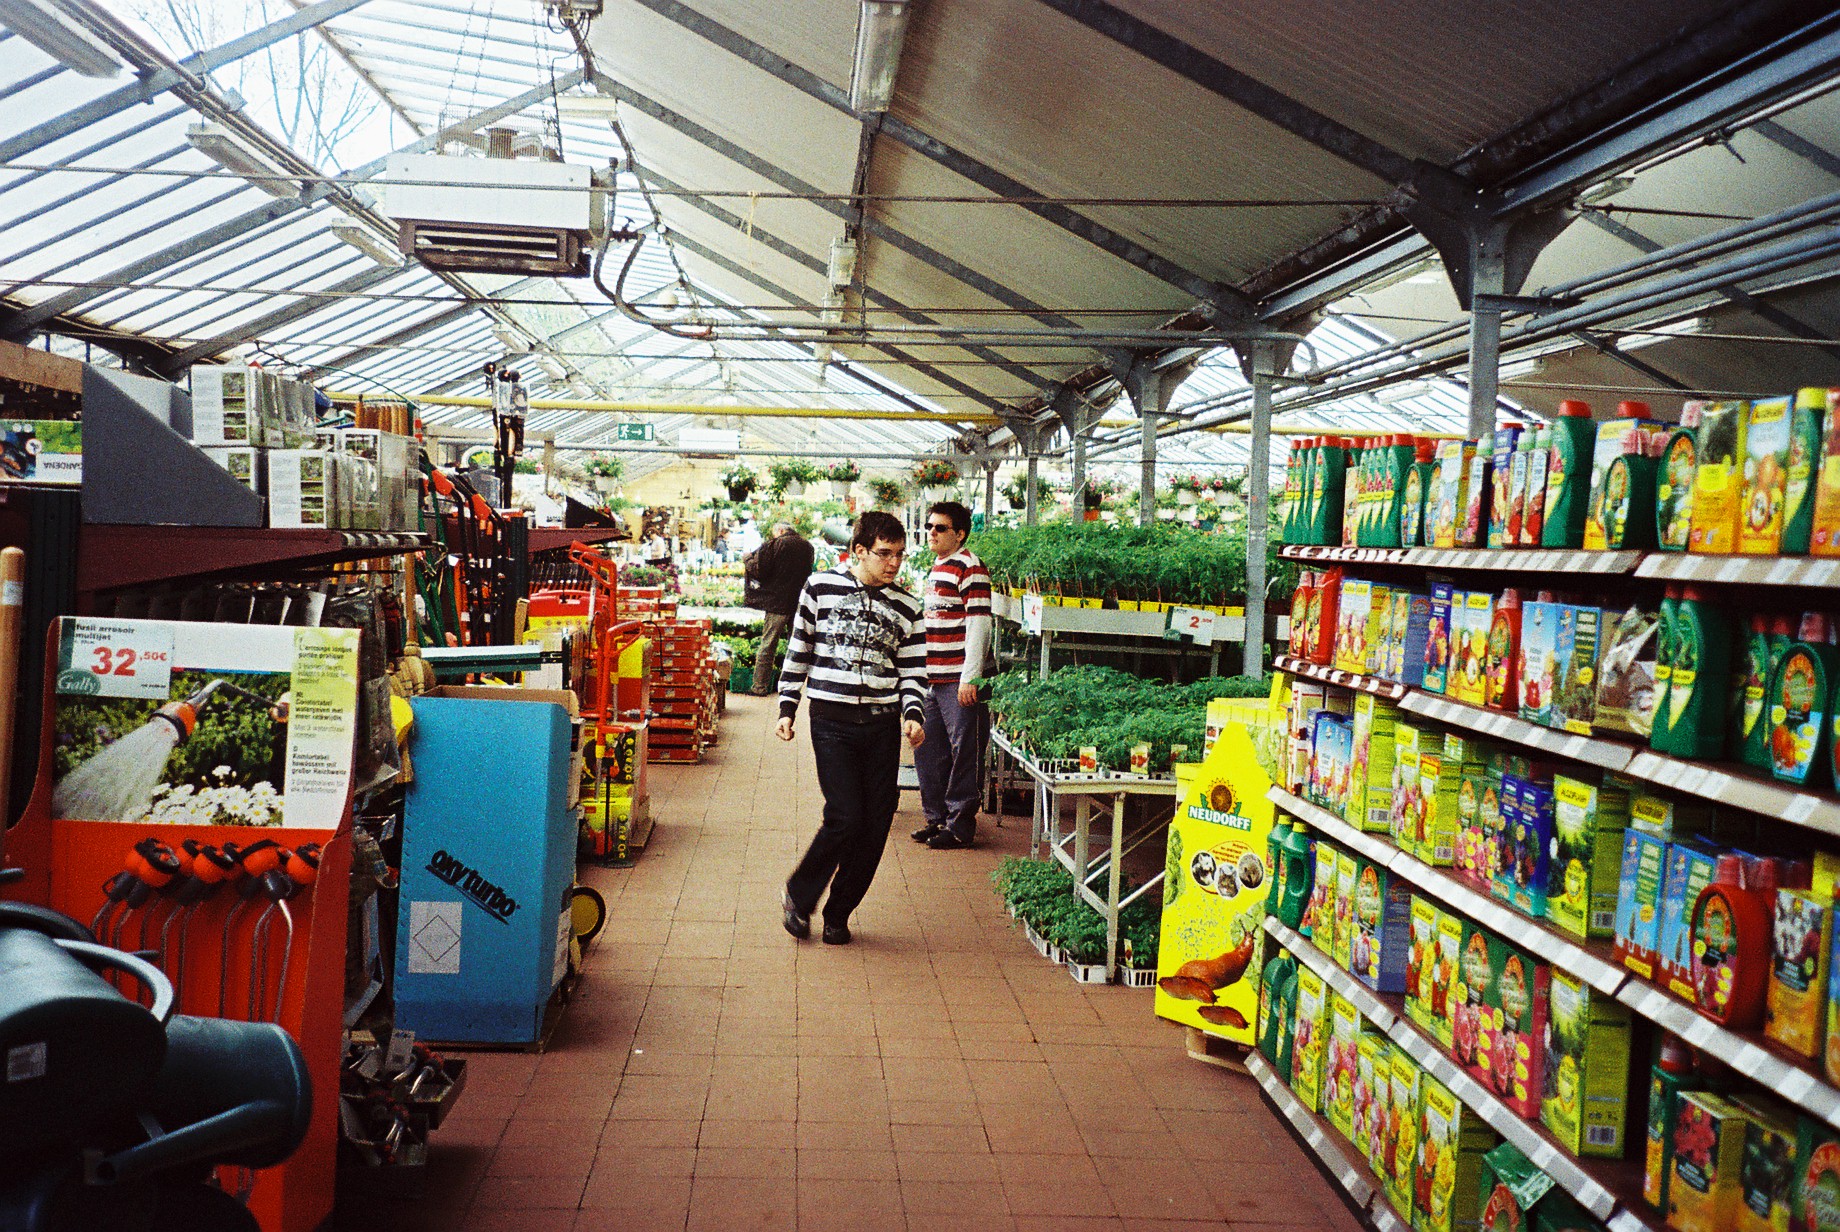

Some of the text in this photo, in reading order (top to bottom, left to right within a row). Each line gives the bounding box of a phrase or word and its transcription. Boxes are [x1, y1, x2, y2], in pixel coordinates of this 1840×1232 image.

[1189, 616, 1200, 628] 2
[91, 646, 136, 677] 32
[58, 674, 98, 692] Gally
[1189, 805, 1251, 831] NEUDORFF
[431, 849, 517, 918] oxyturbo
